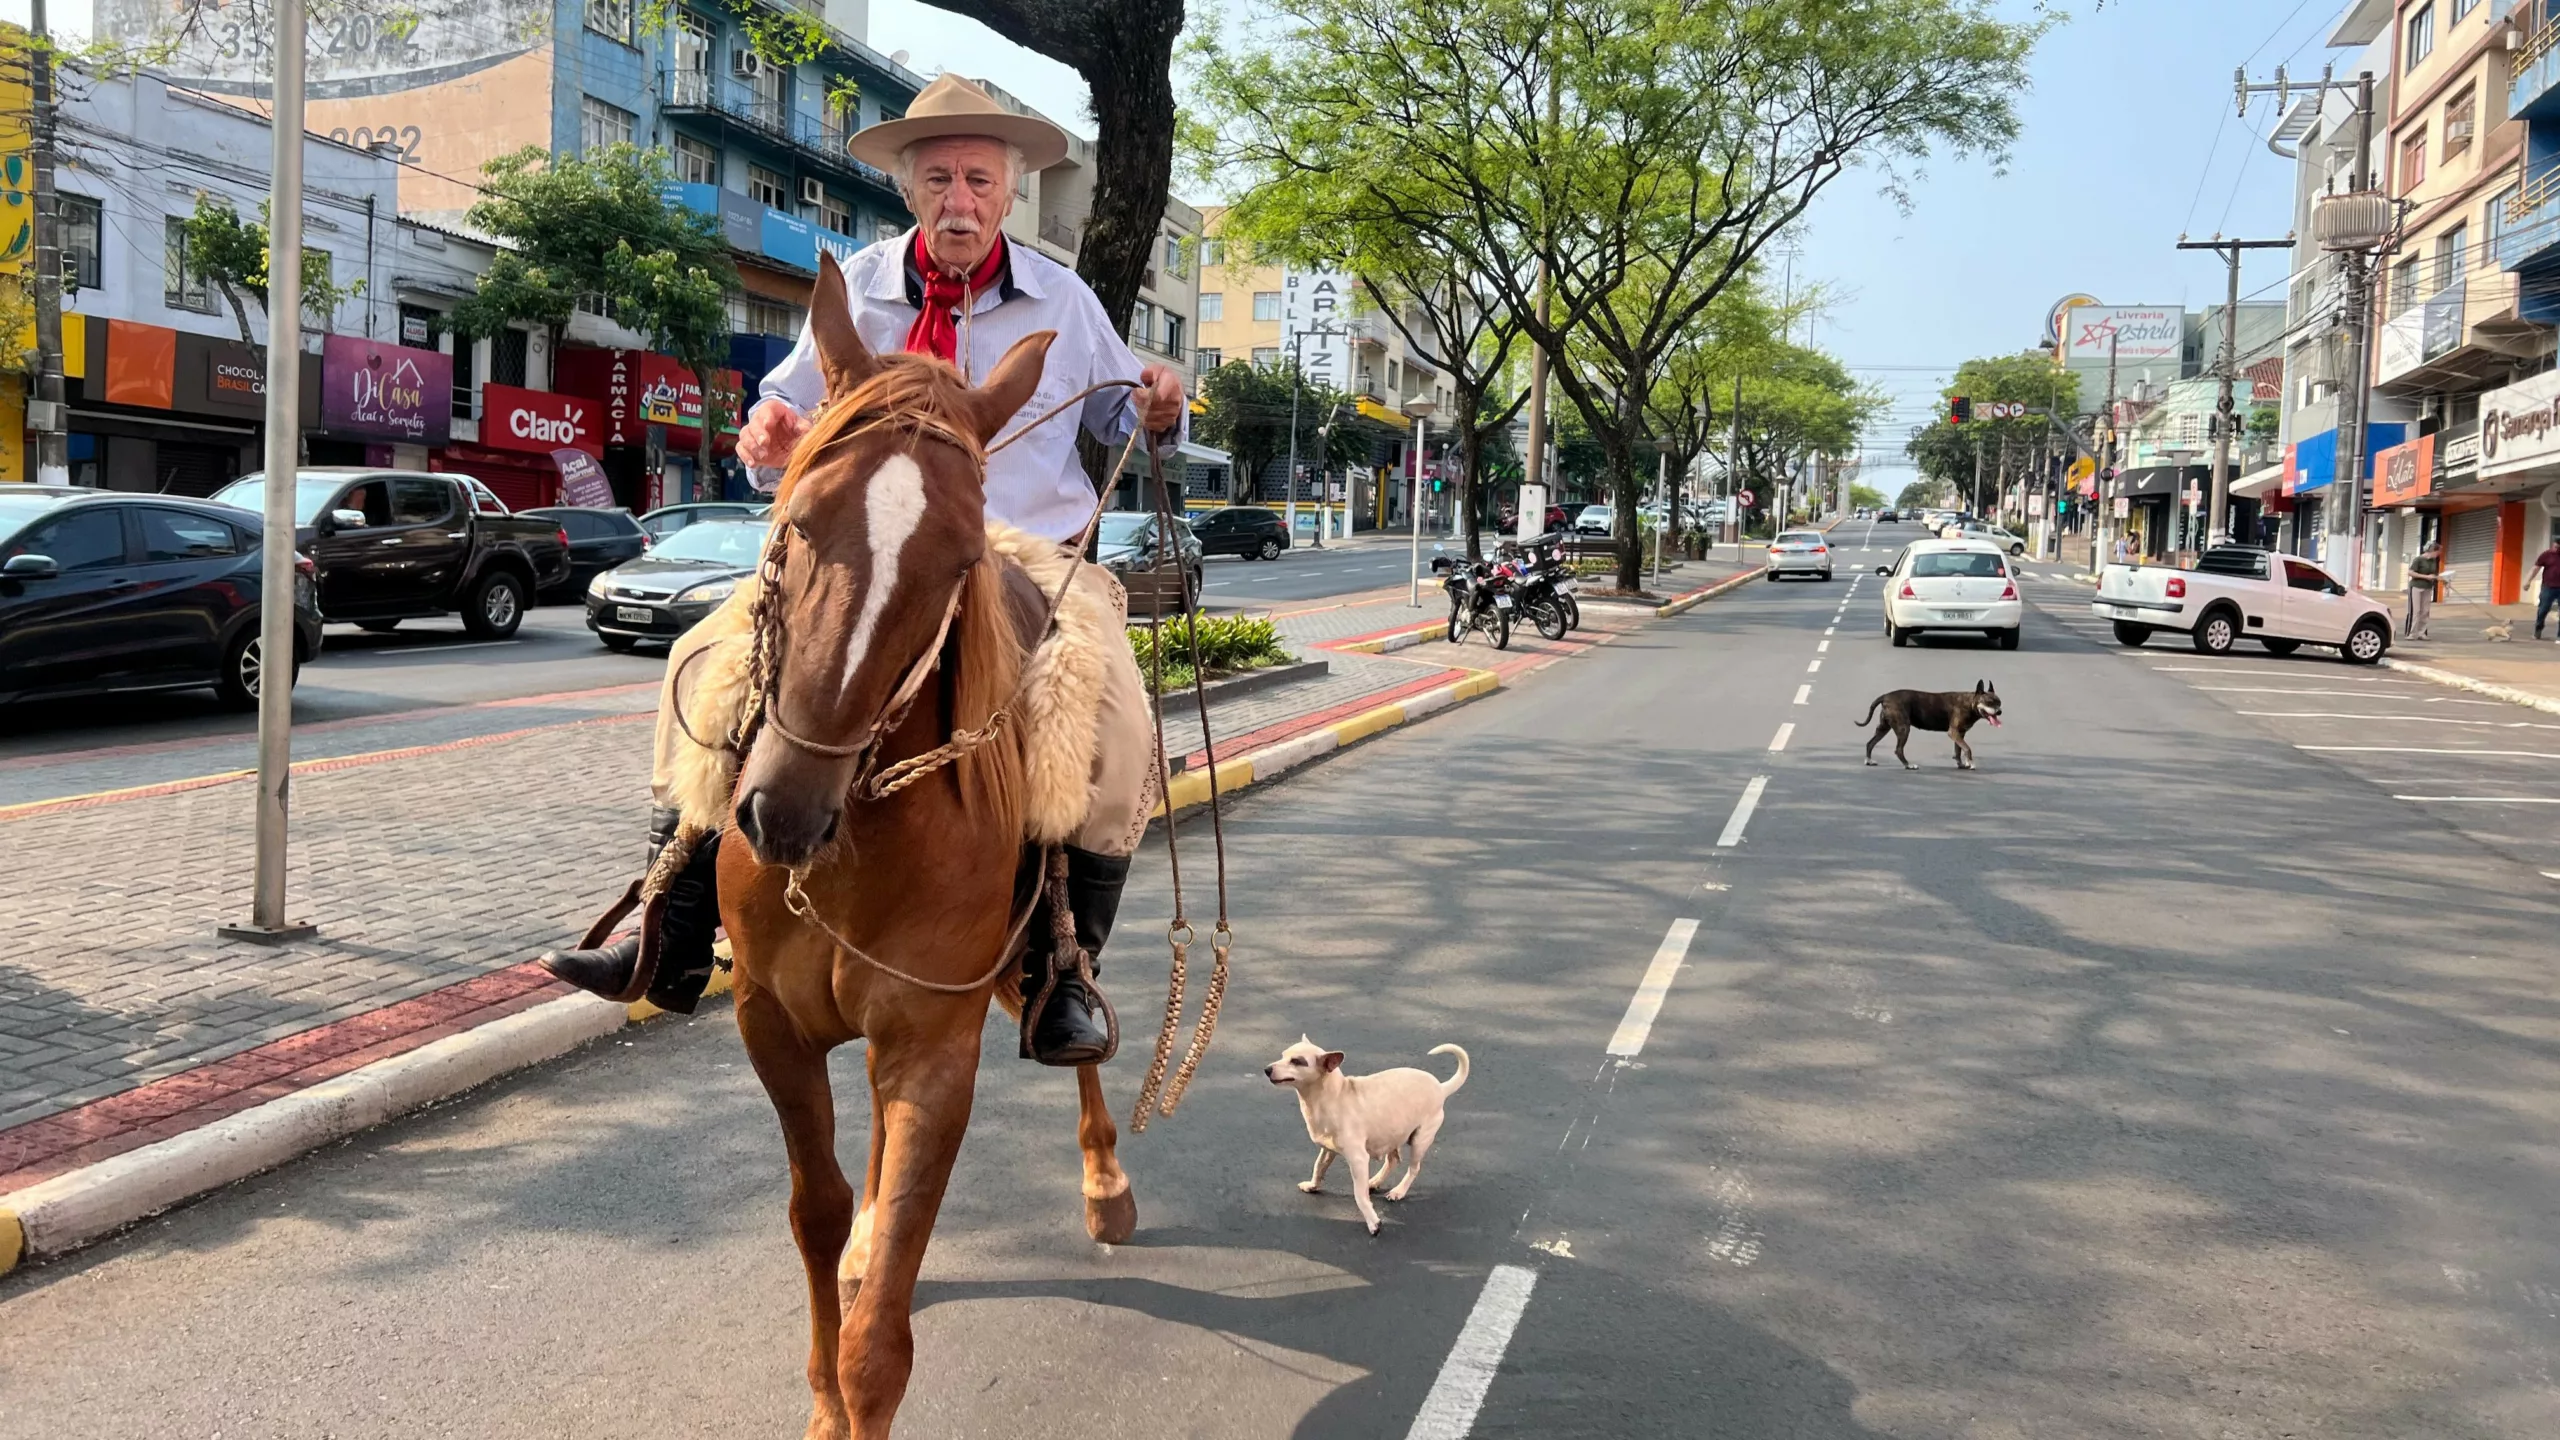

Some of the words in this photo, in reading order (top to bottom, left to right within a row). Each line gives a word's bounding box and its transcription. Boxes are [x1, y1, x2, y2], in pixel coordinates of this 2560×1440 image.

[2116, 311, 2164, 319] Livraria
[2117, 318, 2177, 343] estrela
[611, 350, 627, 442] FARMÁCIA
[388, 408, 425, 429] Sorvetes
[509, 408, 575, 444] Claro
[562, 454, 588, 474] Açaí
